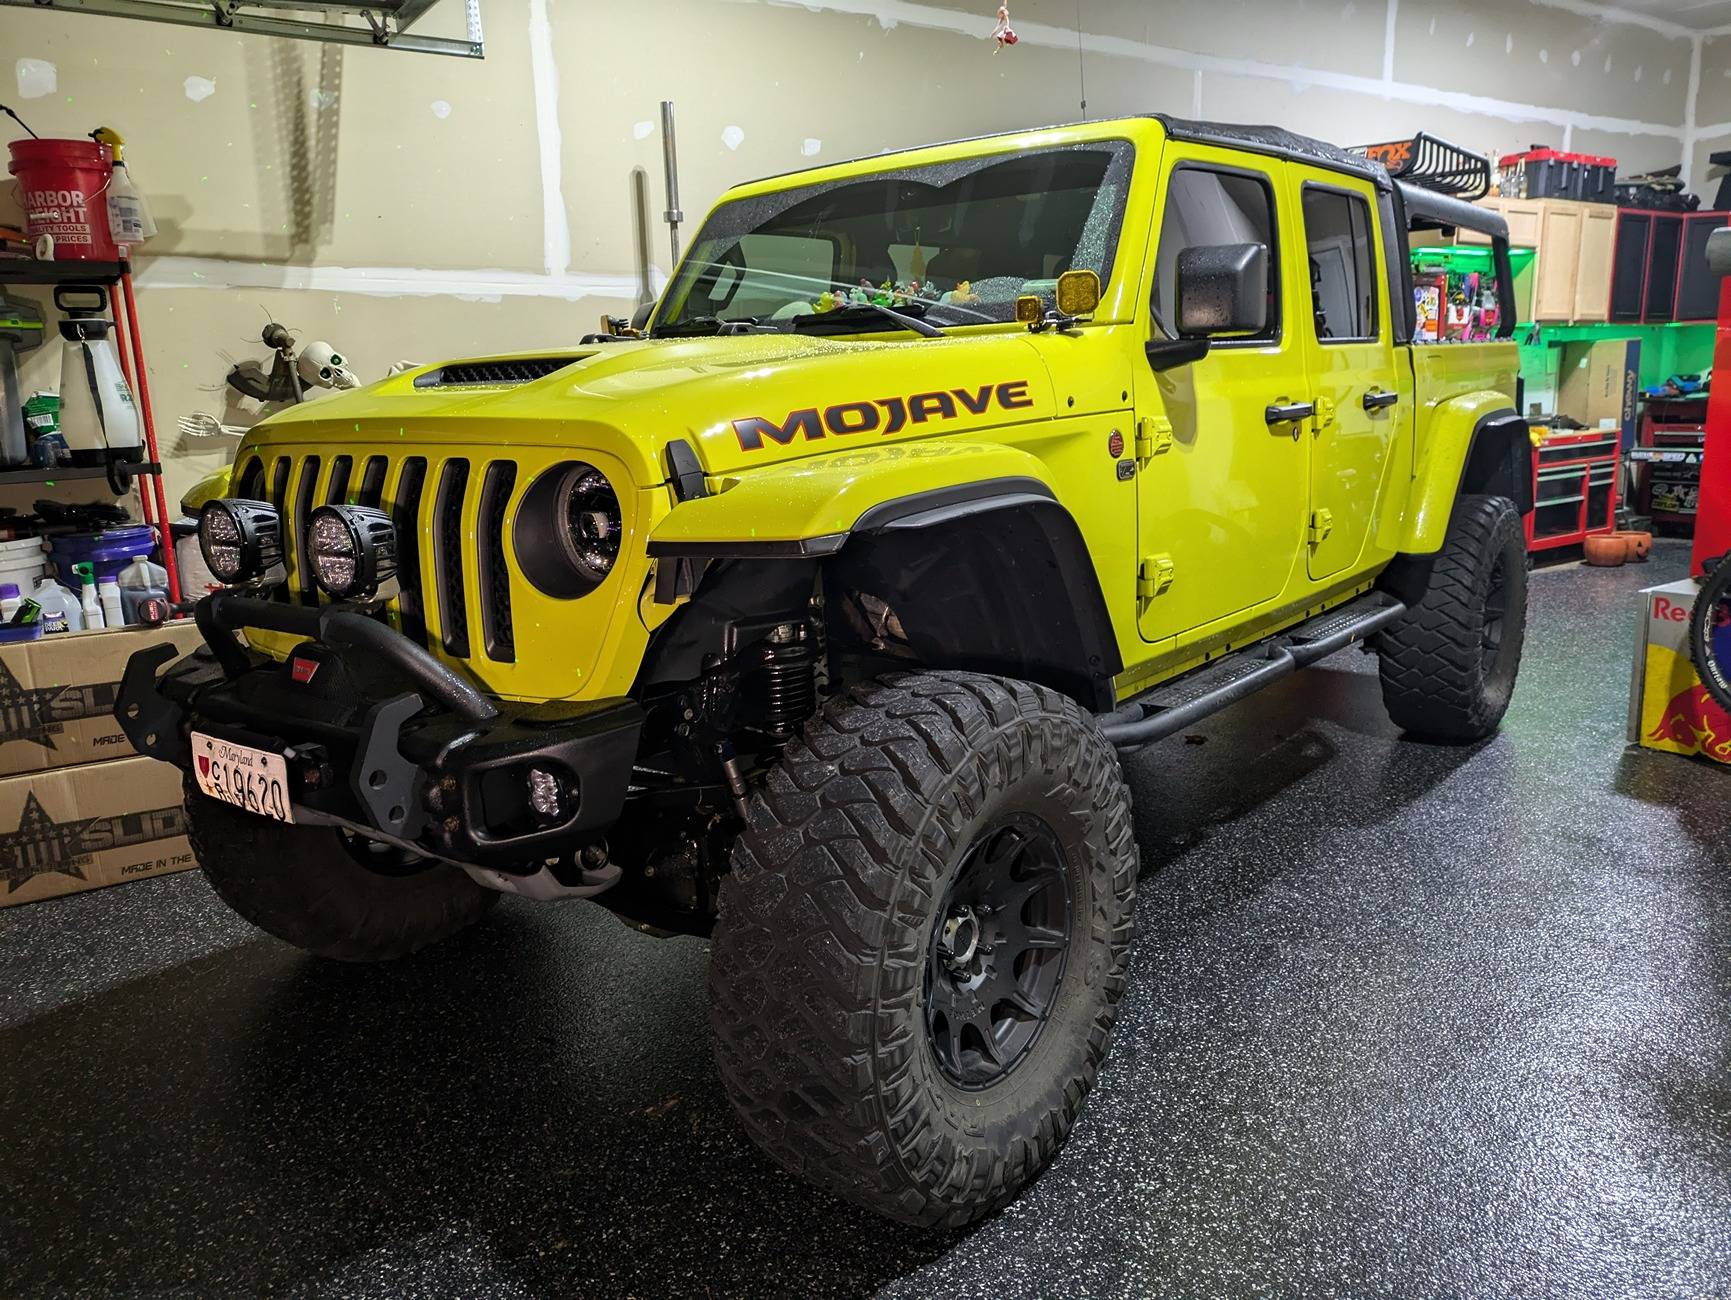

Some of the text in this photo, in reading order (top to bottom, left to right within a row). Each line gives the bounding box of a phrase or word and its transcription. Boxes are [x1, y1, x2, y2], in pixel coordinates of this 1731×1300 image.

[56, 224, 87, 232] TOOLS
[56, 235, 88, 243] PRICES
[731, 380, 1034, 452] MOJAVE
[1653, 597, 1694, 623] Re
[93, 733, 126, 747] MADE
[219, 745, 254, 768] Maryland
[121, 854, 192, 876] MADE IN THE
